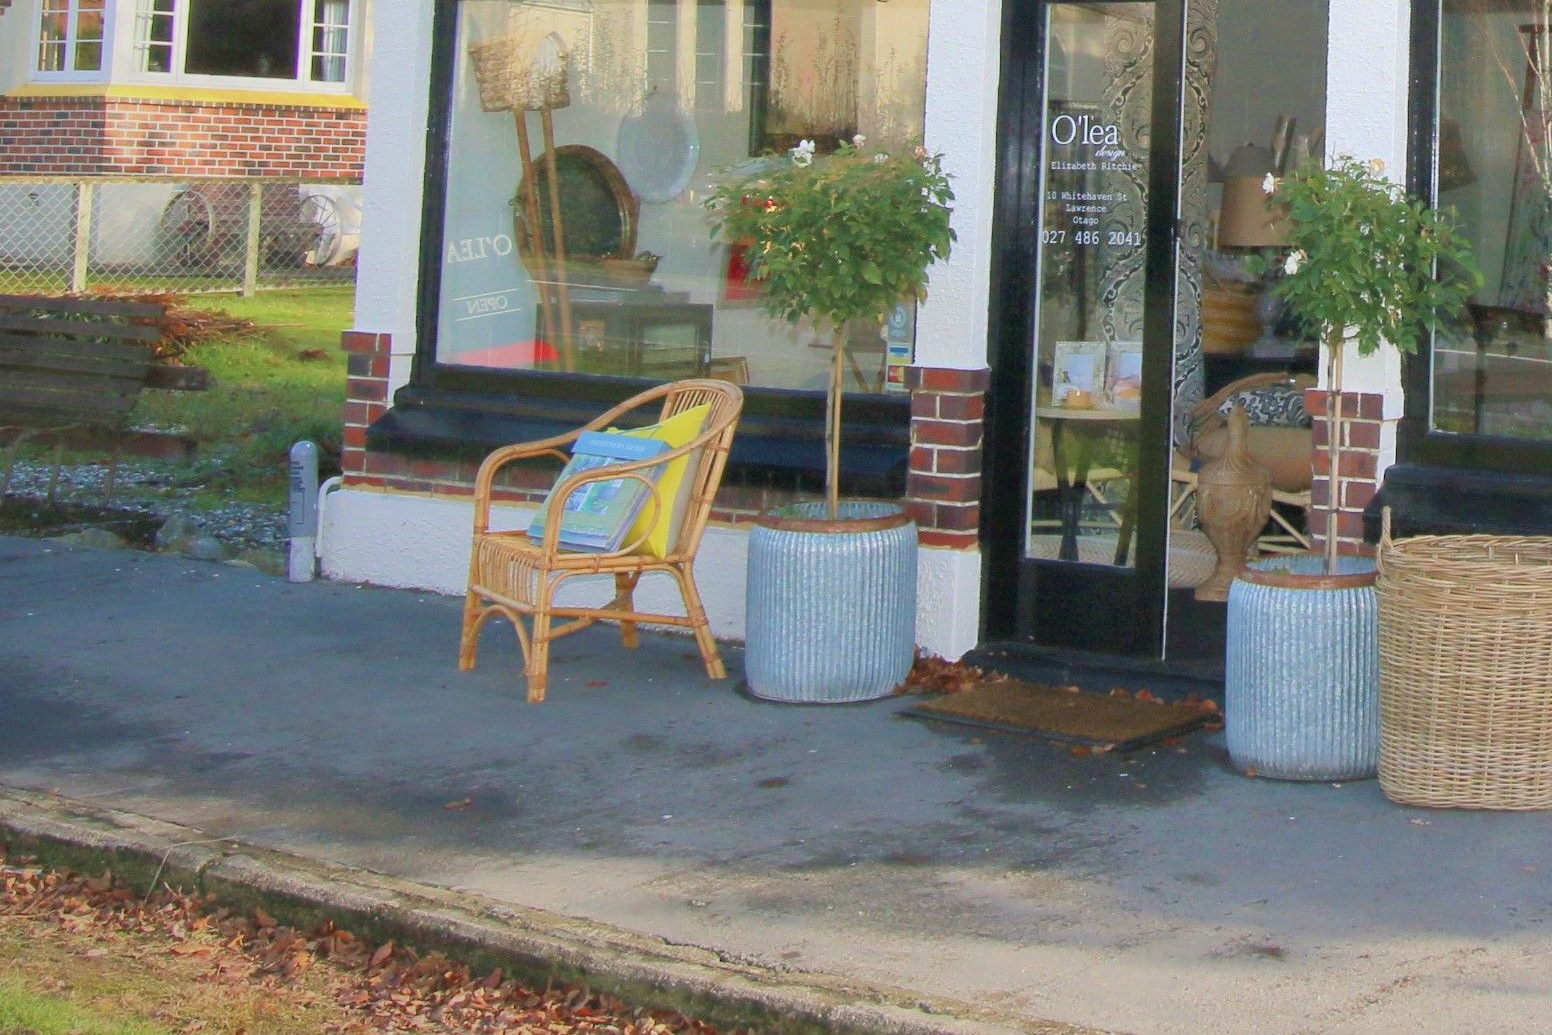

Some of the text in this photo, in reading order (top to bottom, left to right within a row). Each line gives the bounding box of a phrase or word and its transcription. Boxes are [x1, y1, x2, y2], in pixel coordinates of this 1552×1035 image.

[1052, 115, 1119, 145] O'lea
[1095, 144, 1126, 161] design
[1051, 161, 1139, 171] Elizabeth Ritchie
[1061, 190, 1113, 201] Whitehaven
[1117, 192, 1127, 201] St
[1065, 203, 1107, 213] Lawrence
[1072, 216, 1099, 226] Otago
[1042, 230, 1141, 246] 027 486 2041
